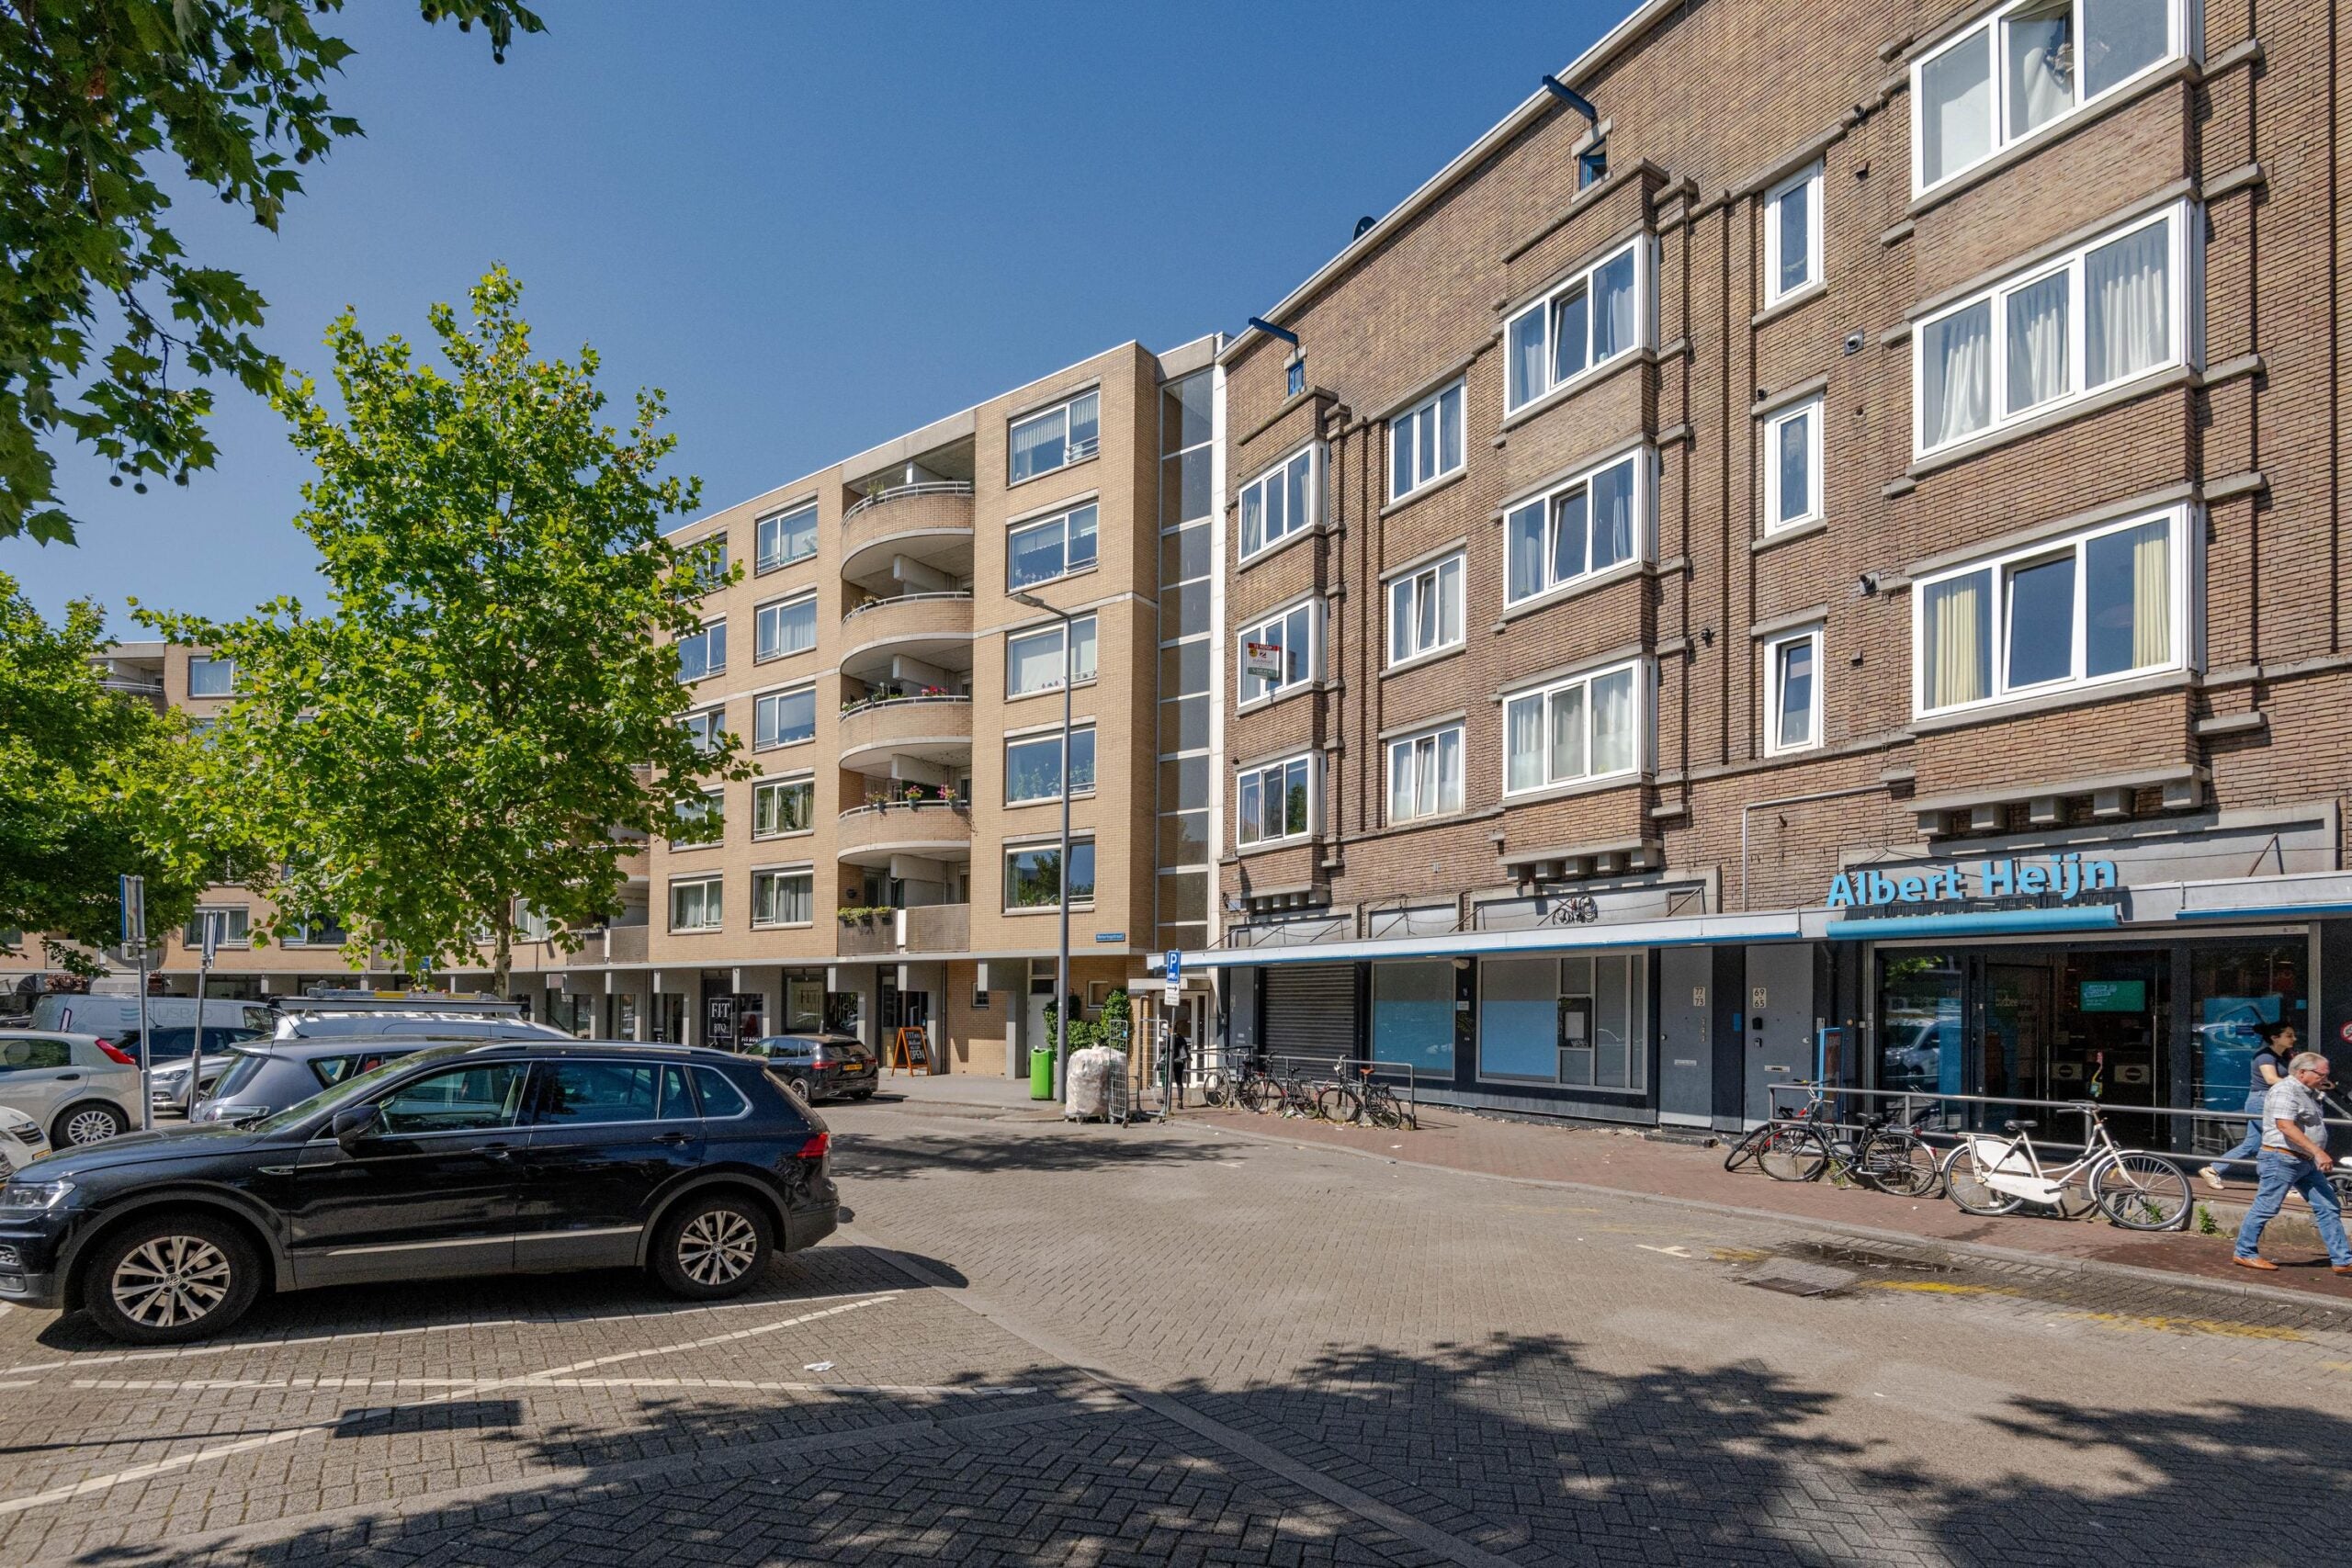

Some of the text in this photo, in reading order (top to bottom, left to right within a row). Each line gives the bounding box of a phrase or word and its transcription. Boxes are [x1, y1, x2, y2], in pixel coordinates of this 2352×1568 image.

[1826, 852, 2117, 908] Albert Heijn
[1170, 953, 1178, 970] P
[1694, 987, 1704, 996] 77
[1754, 988, 1765, 997] 69
[1694, 998, 1704, 1006] 73
[1754, 999, 1765, 1008] 65
[711, 1002, 730, 1018] FIT
[910, 1049, 926, 1060] OPEN
